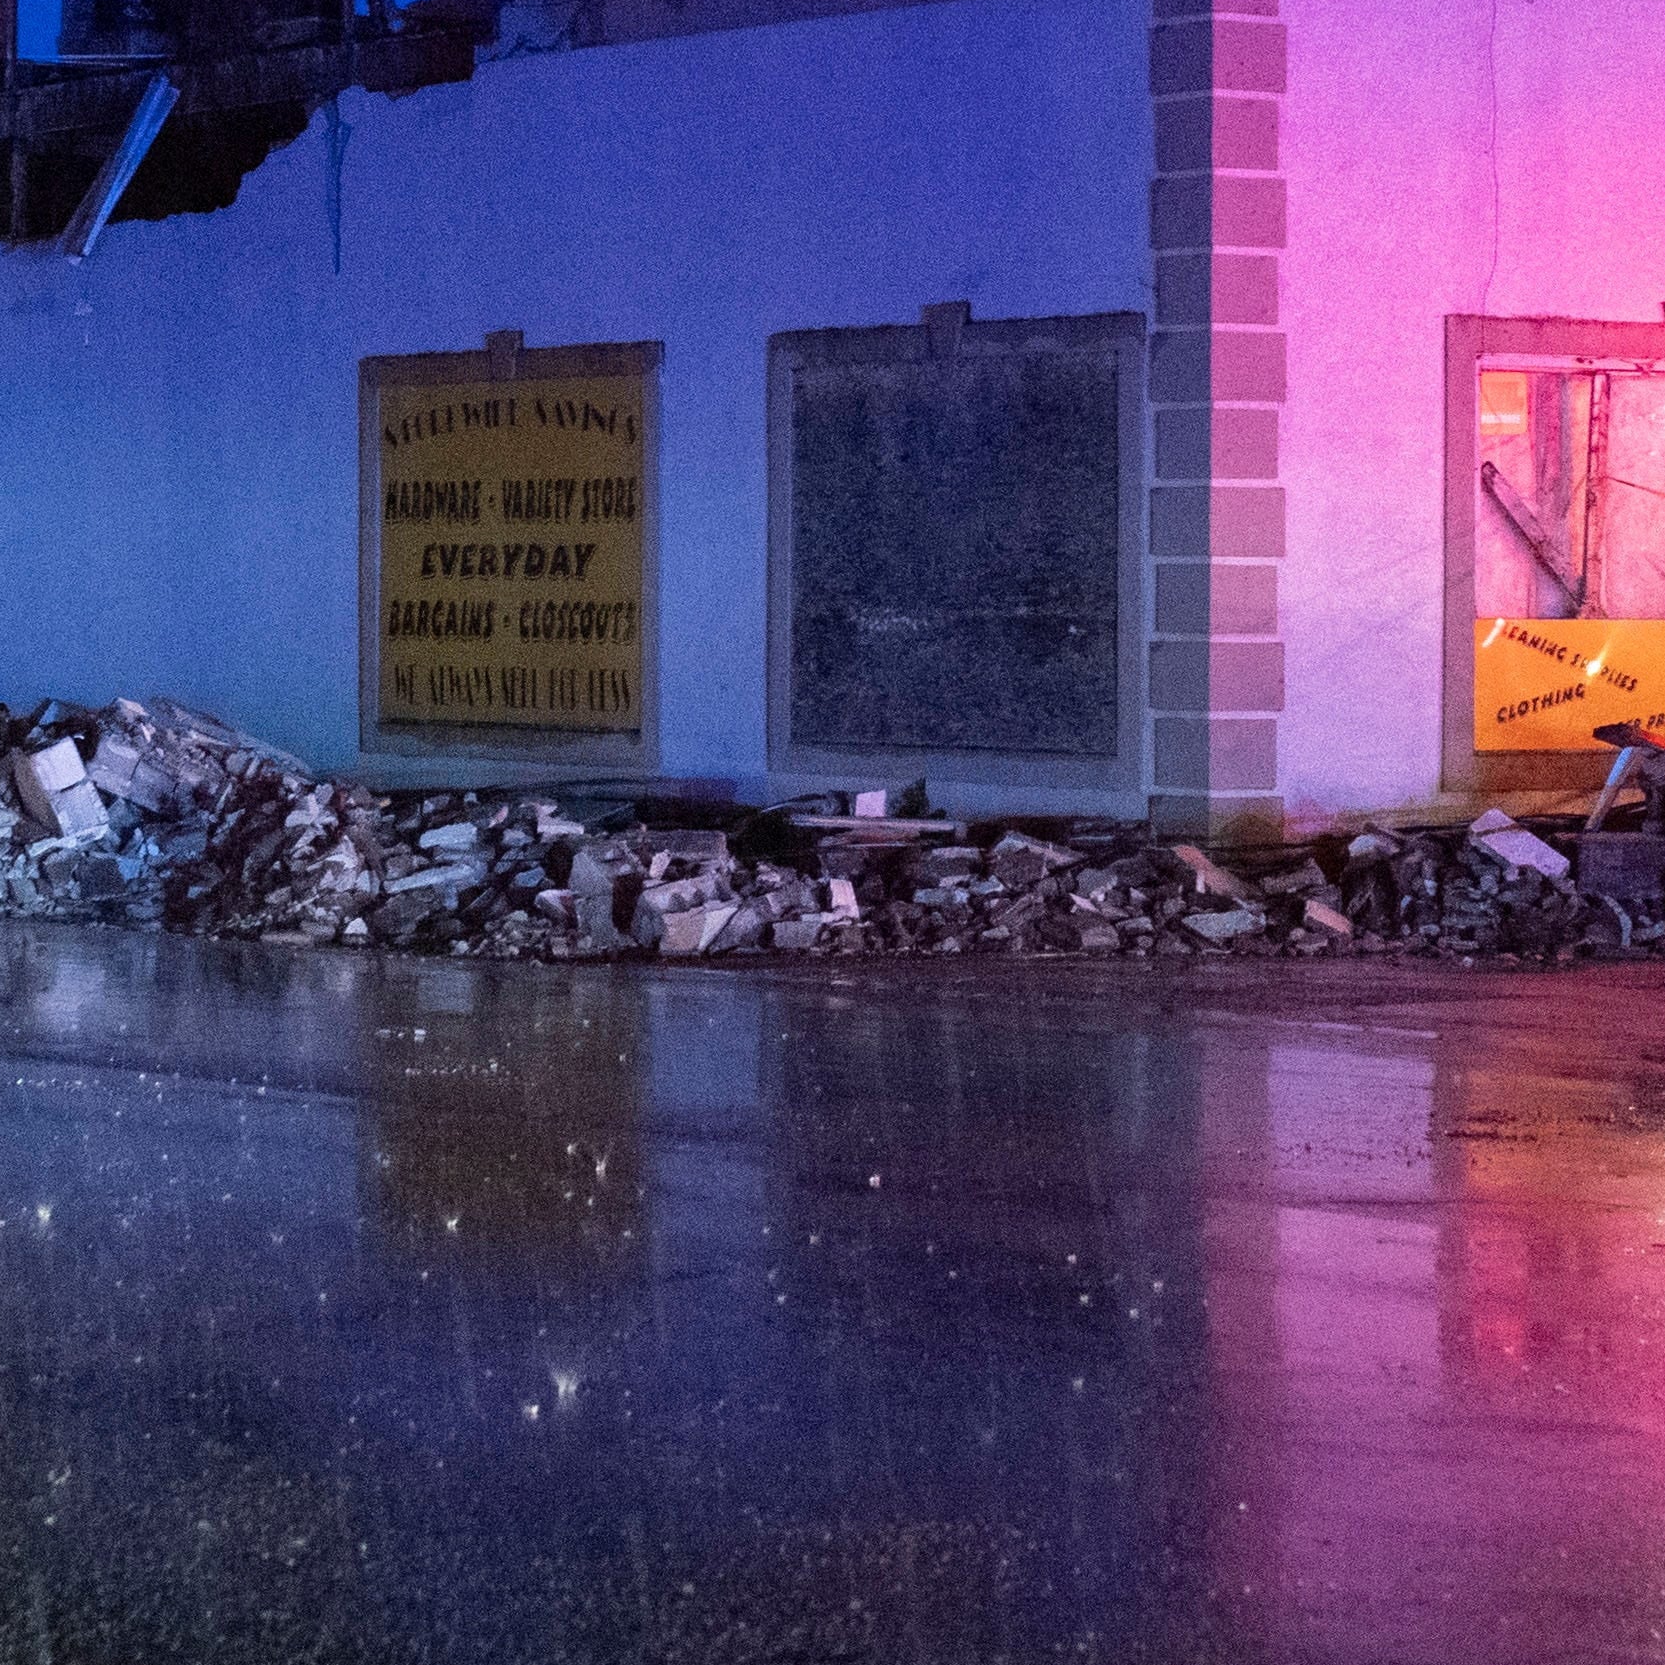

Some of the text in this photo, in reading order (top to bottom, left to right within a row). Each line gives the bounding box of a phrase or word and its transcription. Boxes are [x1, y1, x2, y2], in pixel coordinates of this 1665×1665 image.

[385, 478, 637, 521] HARDWARE VARIETY STORE
[420, 544, 596, 579] EVERYDAY
[389, 600, 637, 641] BARGAINS CLOSEOUTS
[1498, 622, 1567, 663] LEANING
[1496, 683, 1586, 724] CLOTHING
